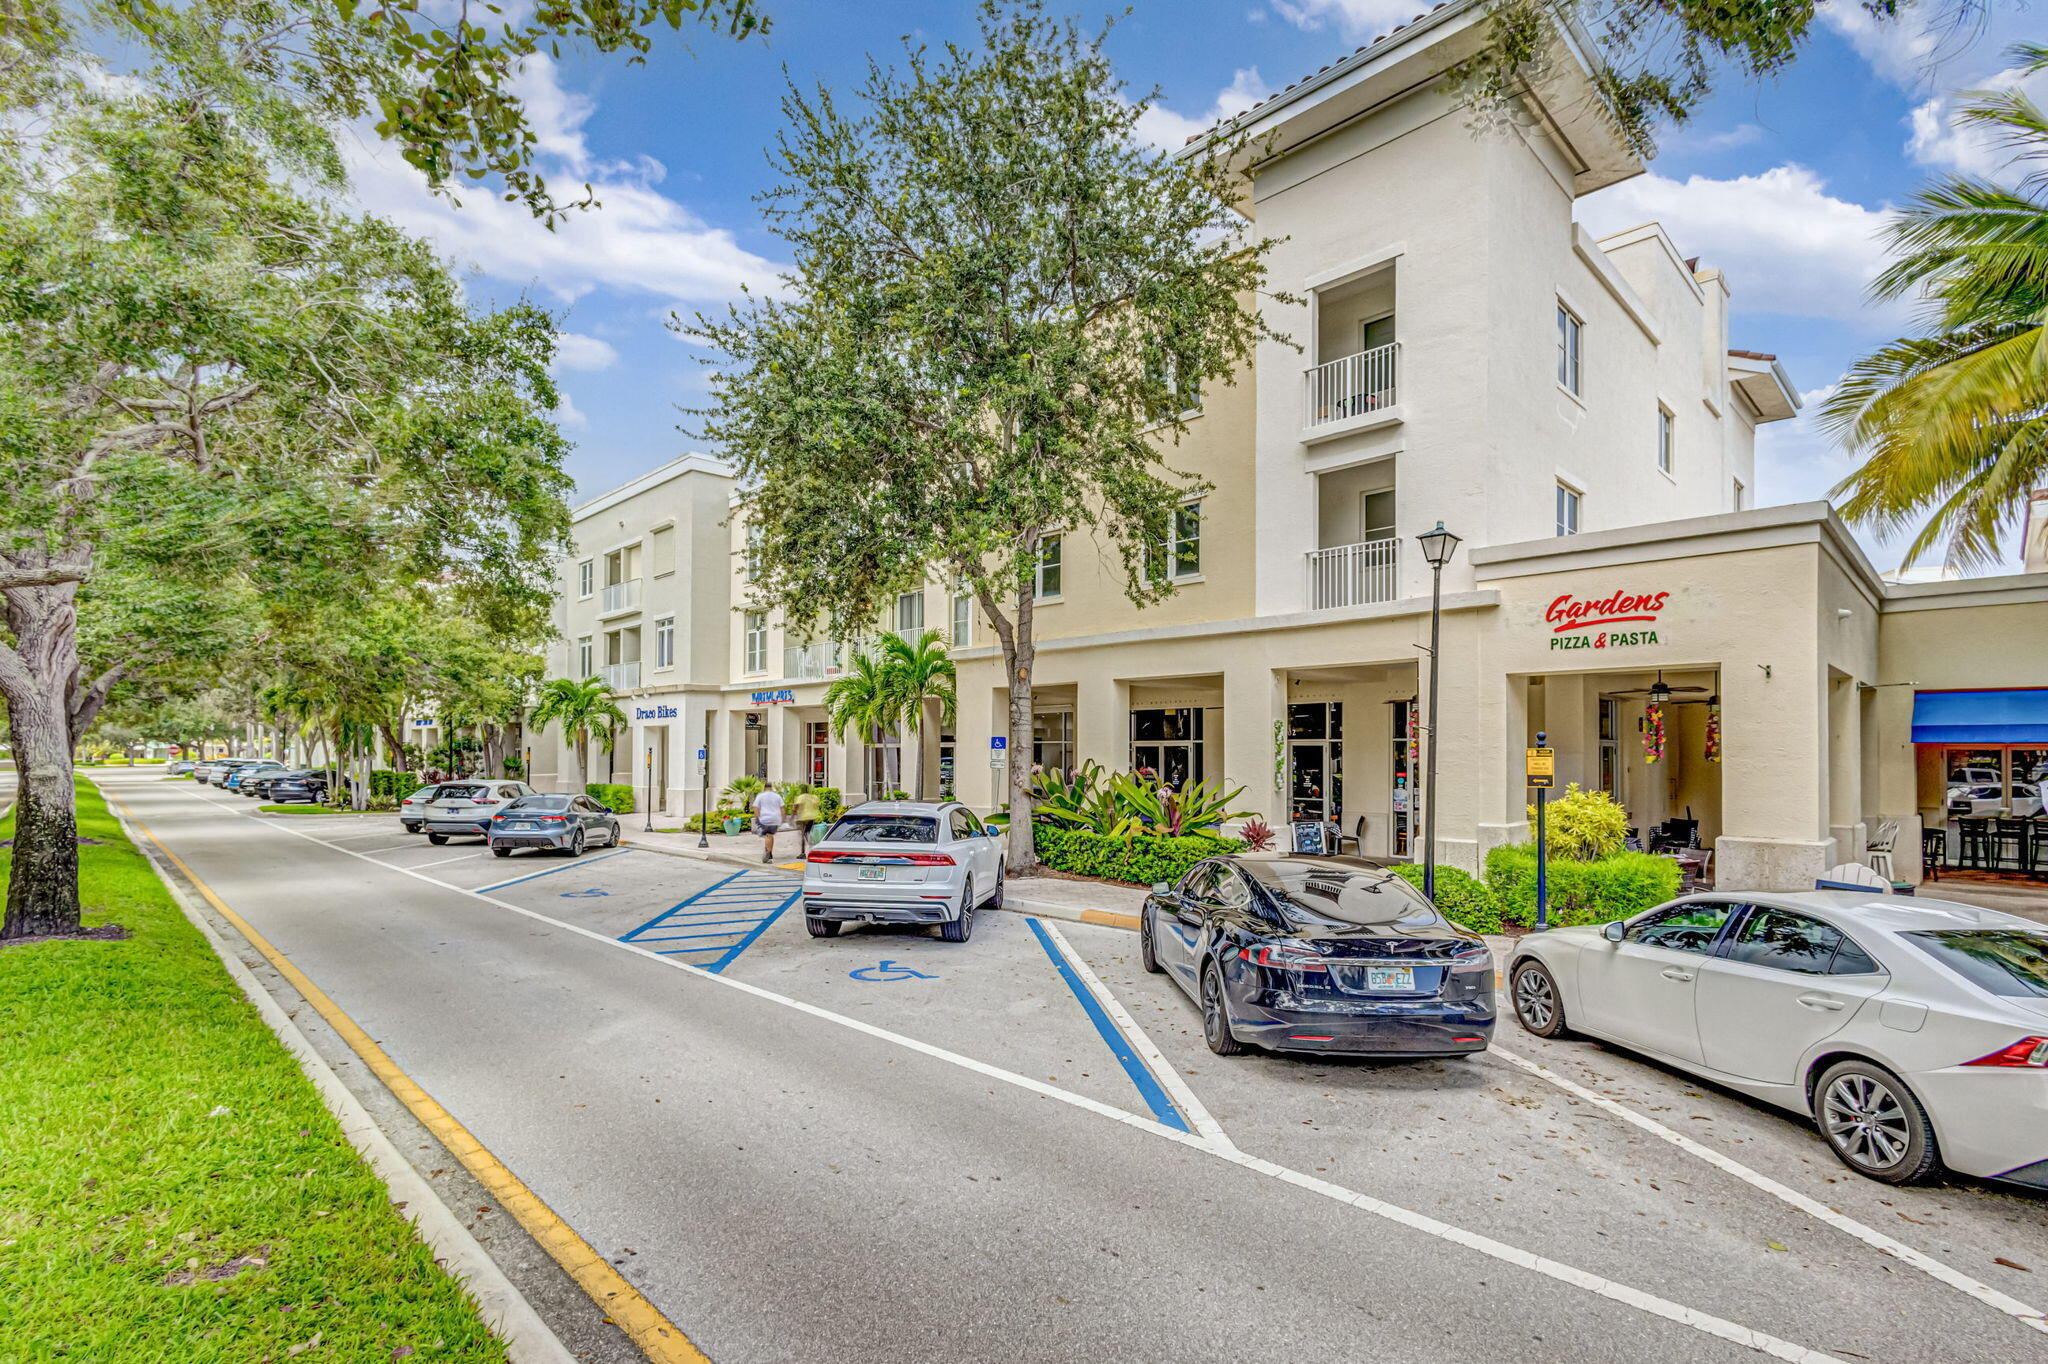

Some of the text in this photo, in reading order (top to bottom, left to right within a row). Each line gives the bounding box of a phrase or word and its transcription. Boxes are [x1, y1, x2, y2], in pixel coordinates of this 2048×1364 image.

[1545, 589, 1670, 623] Gardens
[1550, 631, 1659, 650] PIZZA & PASTA
[636, 705, 678, 720] Draco Bikes
